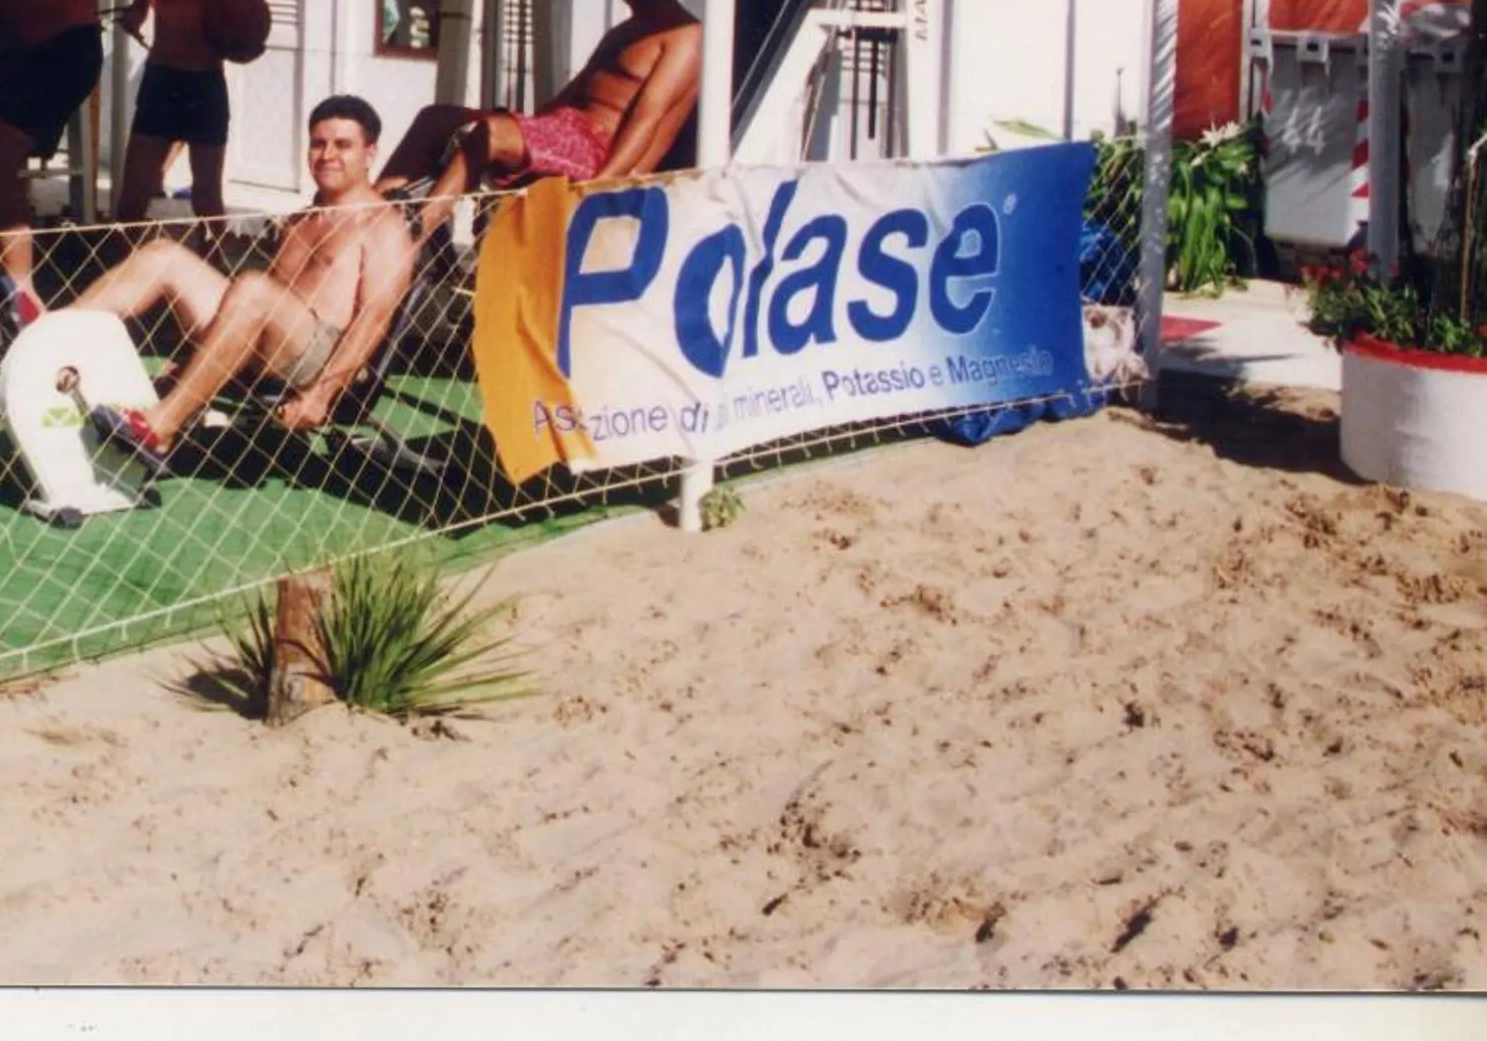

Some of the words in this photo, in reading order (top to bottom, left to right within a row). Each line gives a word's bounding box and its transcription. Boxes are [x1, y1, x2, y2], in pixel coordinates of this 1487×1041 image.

[556, 179, 1001, 379] Polase
[679, 401, 709, 434] di
[820, 360, 925, 400] Potassio
[929, 367, 944, 388] e
